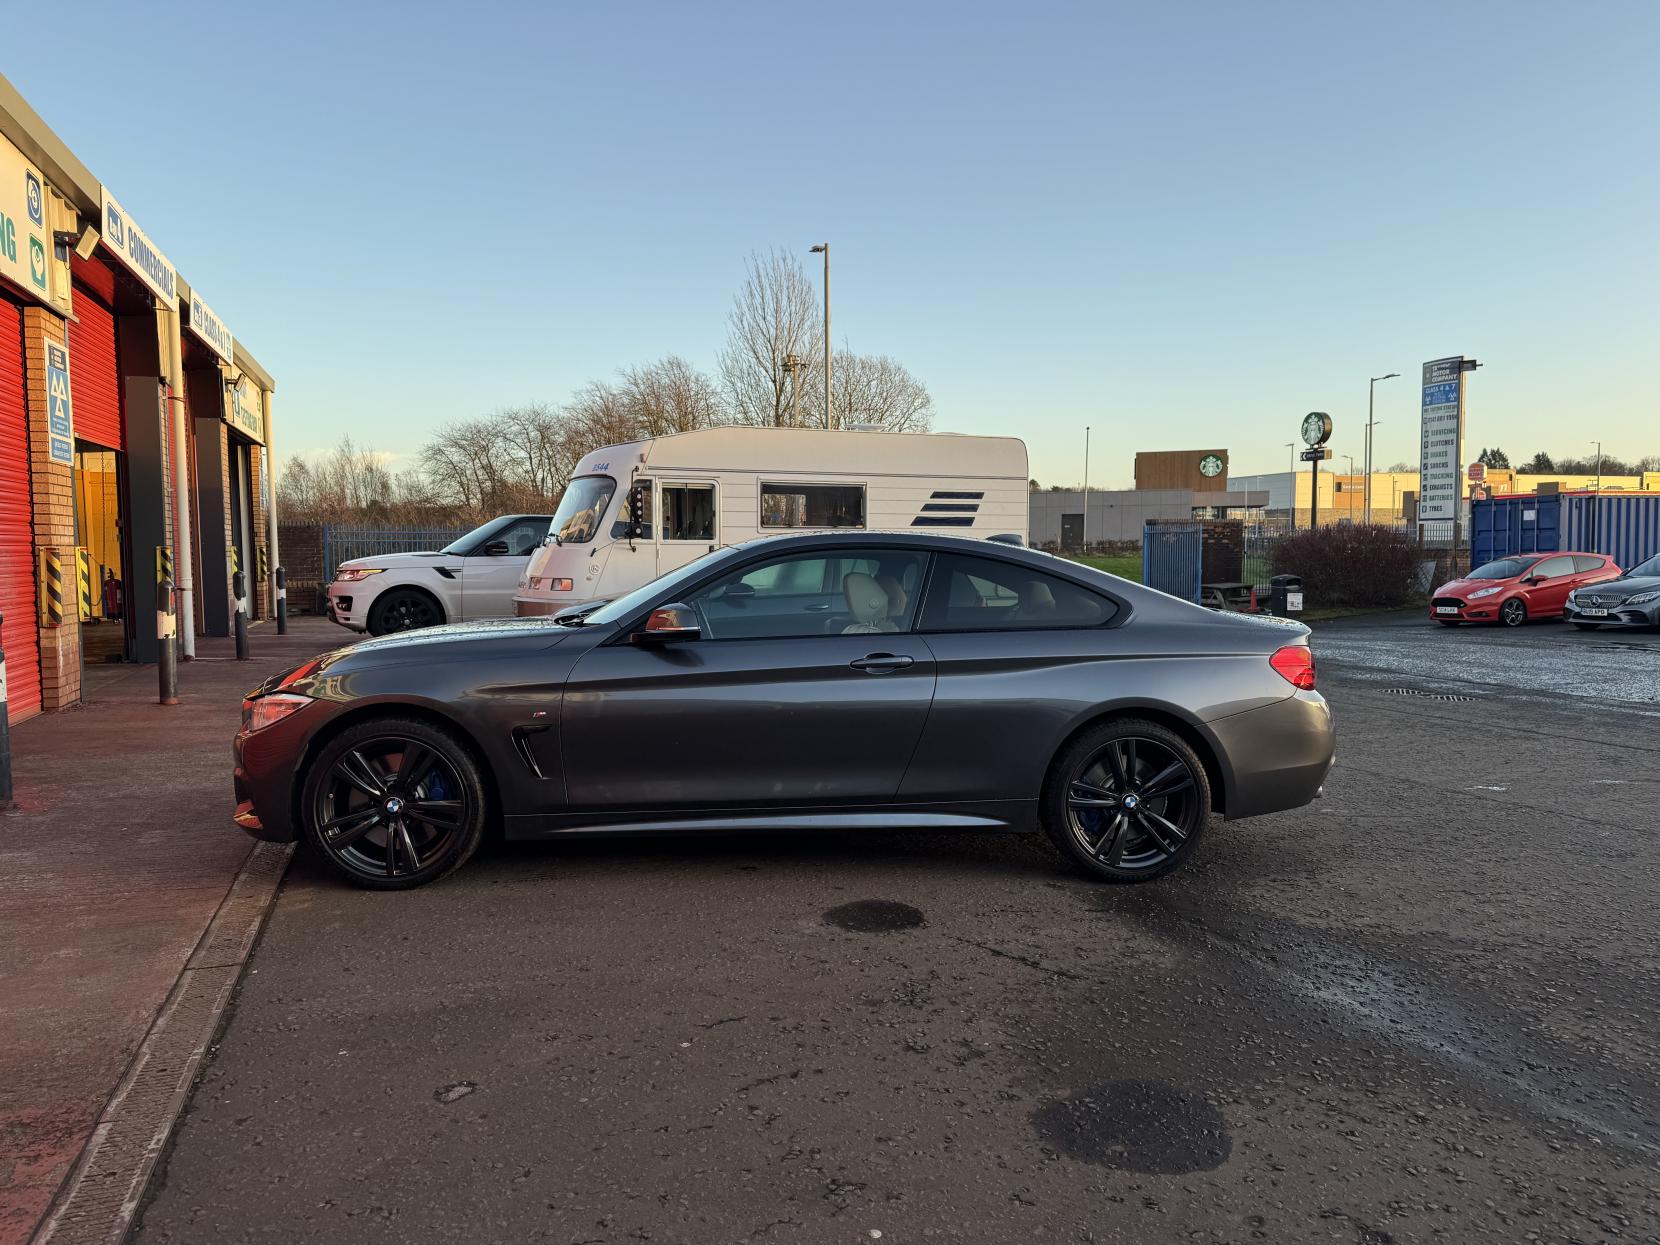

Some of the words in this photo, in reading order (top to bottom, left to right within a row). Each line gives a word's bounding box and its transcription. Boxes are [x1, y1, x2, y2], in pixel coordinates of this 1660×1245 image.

[128, 226, 174, 300] COMMERCIALS
[1432, 369, 1450, 378] MOTOR
[1432, 374, 1458, 383] COMPANY
[1425, 386, 1439, 394] CLASS
[1431, 428, 1457, 436] SERVICING
[1429, 494, 1454, 502] BATTERIES
